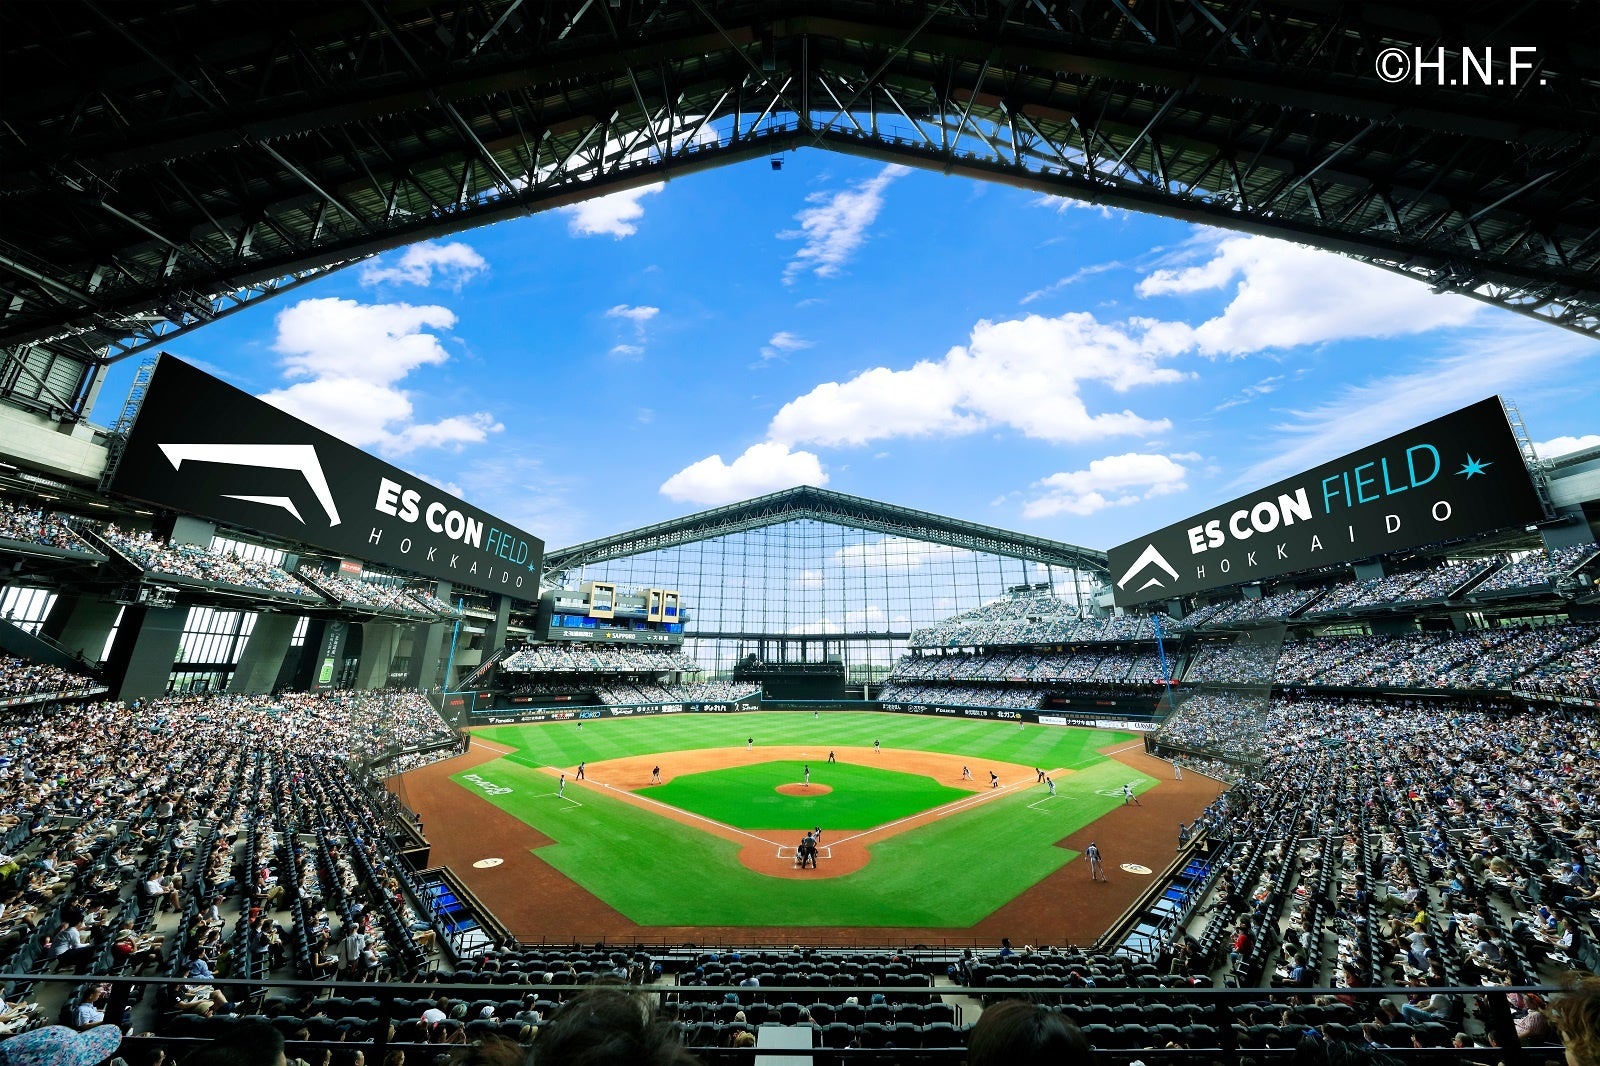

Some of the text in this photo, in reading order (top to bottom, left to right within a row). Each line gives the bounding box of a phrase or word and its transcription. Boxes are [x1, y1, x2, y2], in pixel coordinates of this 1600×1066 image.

[375, 477, 528, 565] ES CON FIELD
[1187, 443, 1441, 555] ES CON FIELD
[368, 527, 523, 588] HOKKAIDO
[1197, 500, 1453, 579] HOKKAIDO
[612, 632, 636, 640] SAPPORO
[997, 711, 1016, 719] 北ガス
